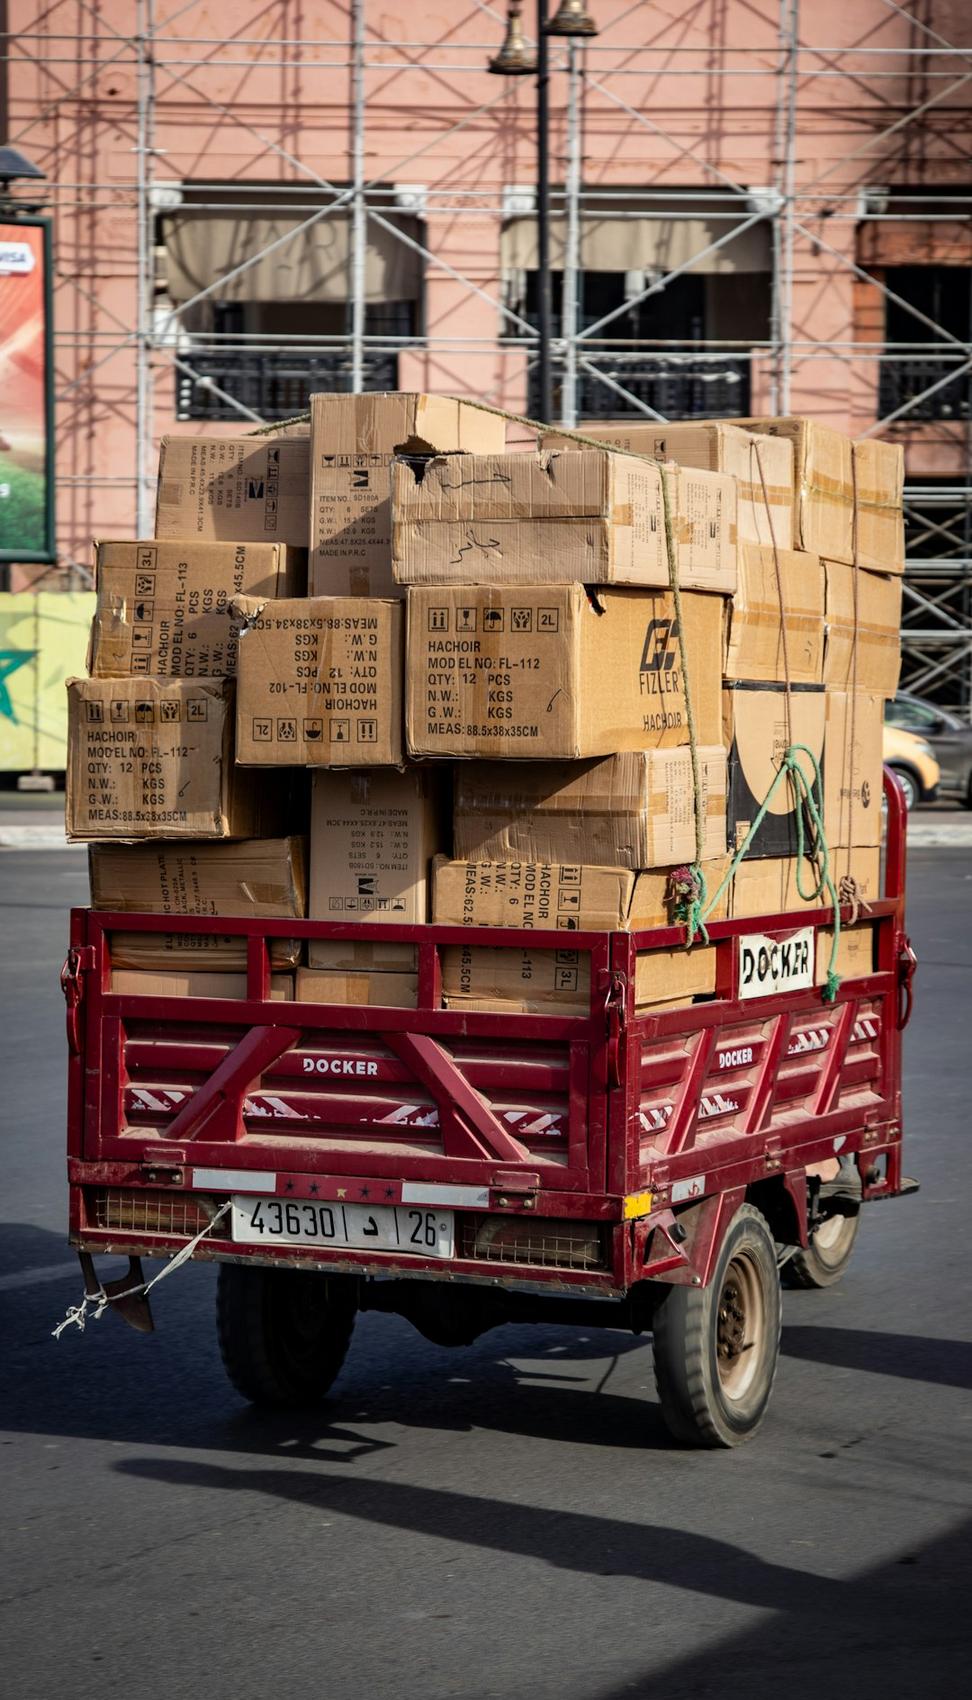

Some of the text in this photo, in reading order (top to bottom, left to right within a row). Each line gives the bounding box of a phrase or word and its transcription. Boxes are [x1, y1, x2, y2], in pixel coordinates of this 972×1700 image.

[141, 552, 152, 567] 3L
[176, 563, 187, 602] FL-113
[188, 591, 199, 614] PCS
[202, 589, 213, 614] KGS
[215, 590, 226, 615] KGS
[541, 614, 555, 626] 2L
[295, 634, 318, 645] KGS
[158, 621, 169, 676] HACHOIR
[428, 641, 481, 652] HACHOIR
[185, 648, 195, 676] QTY:
[294, 651, 377, 661] N.W.: KGS
[428, 658, 540, 669] MODEL NO: FL-112
[297, 666, 376, 678] QTY: 12 PCS
[428, 674, 511, 686] QTY: 12 PCS
[640, 671, 679, 695] FIZLER
[269, 683, 307, 694] FL-102
[428, 691, 512, 702] N.W.: KGS
[325, 699, 377, 710] HACHOIR
[191, 706, 204, 716] 2L
[488, 707, 512, 718] KGS
[643, 712, 682, 732] HACHOIR
[256, 724, 269, 735] 2L
[88, 732, 135, 742] HACHOIR
[152, 747, 188, 758] FL-112
[88, 763, 162, 774] QTY: 12 PCS
[88, 779, 165, 789] N.W.: KGS
[142, 794, 165, 805] KGS
[510, 862, 521, 889] QTY:
[161, 884, 170, 902] HOT
[538, 864, 551, 919] HACHOIR
[743, 940, 809, 984] DOCKER
[561, 971, 572, 986] 3L
[720, 1048, 752, 1068] DOCKER
[304, 1058, 377, 1075] DOCKER
[251, 1201, 335, 1238] 43630
[409, 1210, 436, 1246] 26
